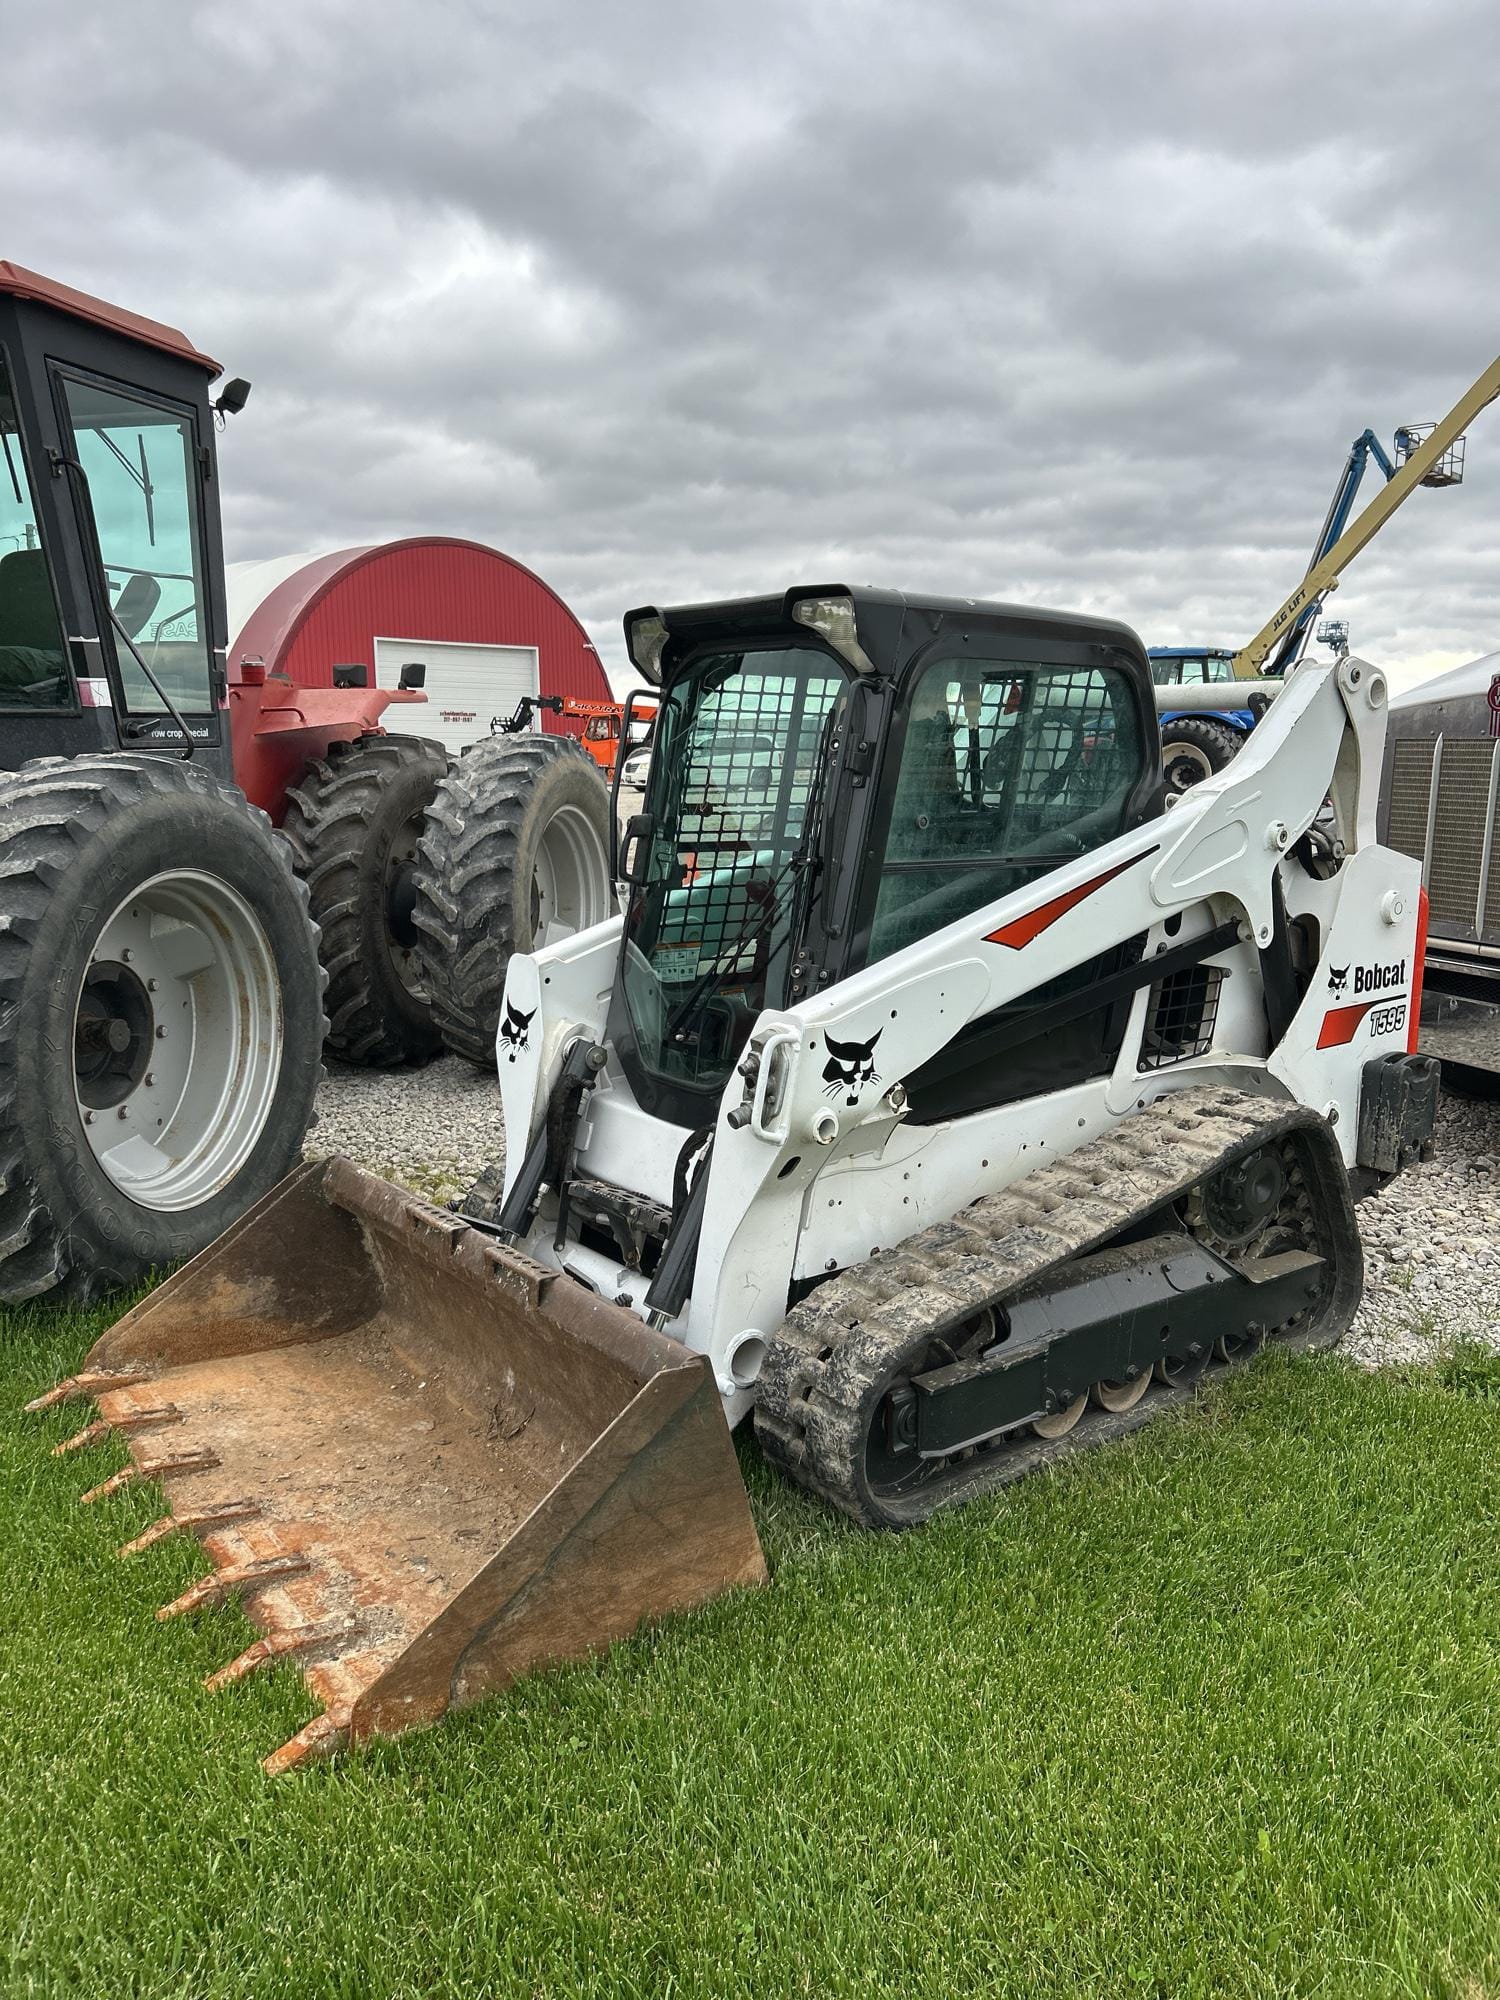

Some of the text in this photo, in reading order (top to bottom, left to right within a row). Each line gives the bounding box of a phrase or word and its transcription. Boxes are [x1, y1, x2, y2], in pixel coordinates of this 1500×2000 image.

[1273, 589, 1306, 632] JLG LIFT
[575, 703, 625, 713] SKYTRA
[151, 730, 165, 738] row
[166, 730, 183, 739] crop
[1354, 959, 1406, 994] Bobcat
[1370, 1004, 1407, 1037] T595
